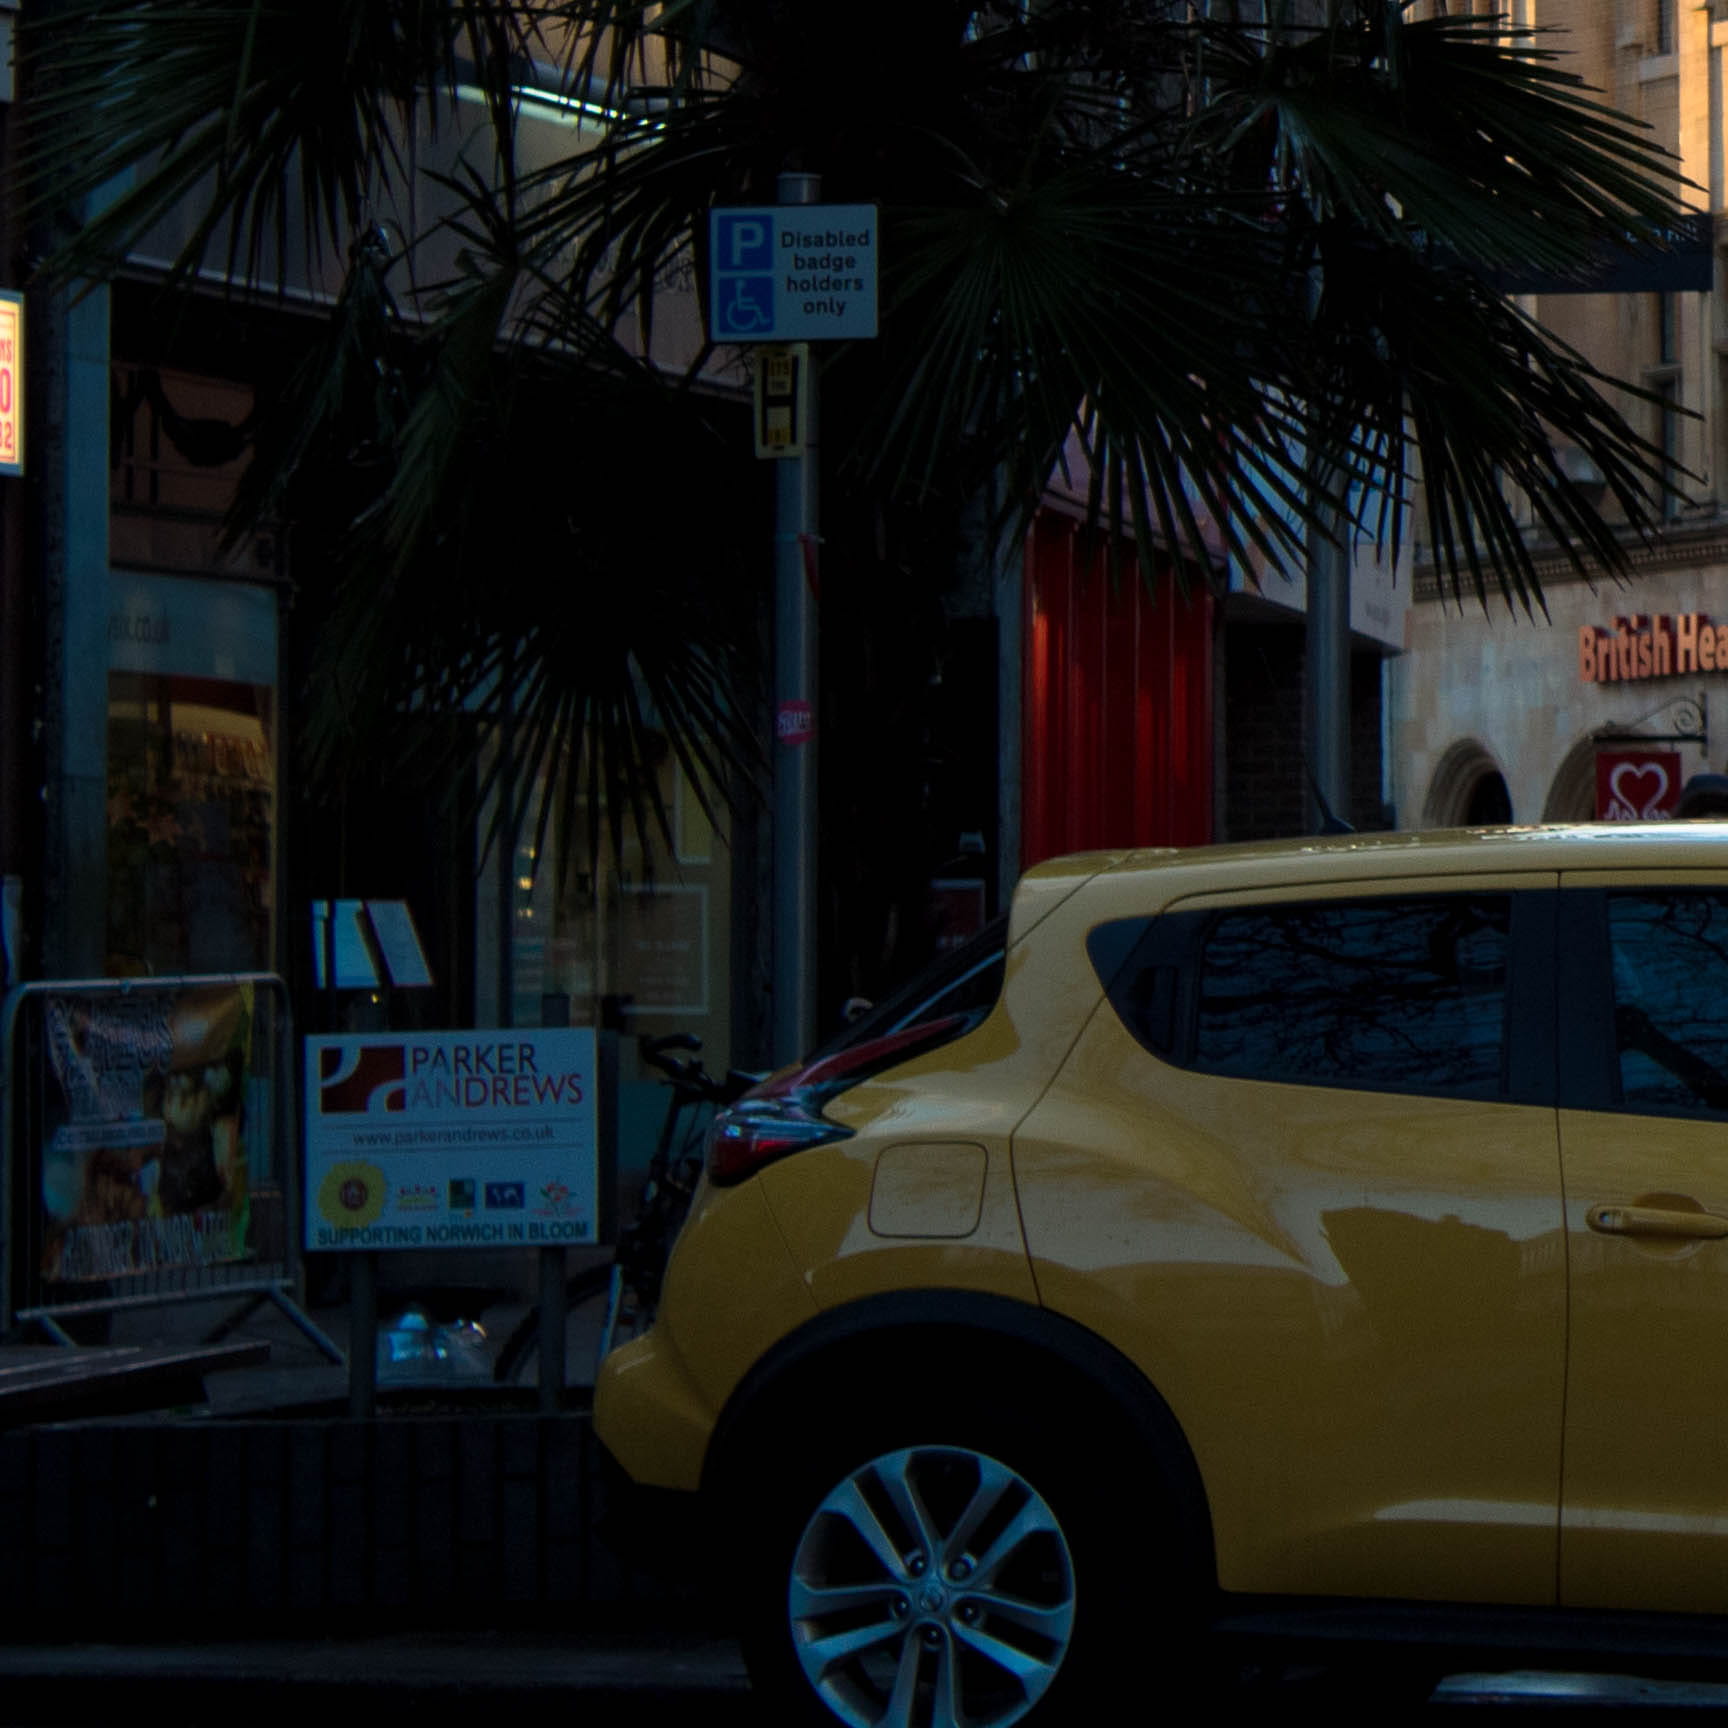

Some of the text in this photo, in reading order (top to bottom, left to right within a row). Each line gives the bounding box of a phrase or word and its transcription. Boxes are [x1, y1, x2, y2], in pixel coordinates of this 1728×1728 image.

[781, 229, 869, 248] Disabled
[794, 253, 856, 272] badge
[786, 276, 864, 293] holders
[803, 296, 846, 316] only
[1579, 614, 1675, 682] British
[412, 1043, 538, 1074] PARKER
[411, 1073, 584, 1108] ANDREWS
[352, 1125, 555, 1147] www.parkerandrews.co.uk
[317, 1221, 588, 1246] SUPPORTING NORWICH IN BLOOM
